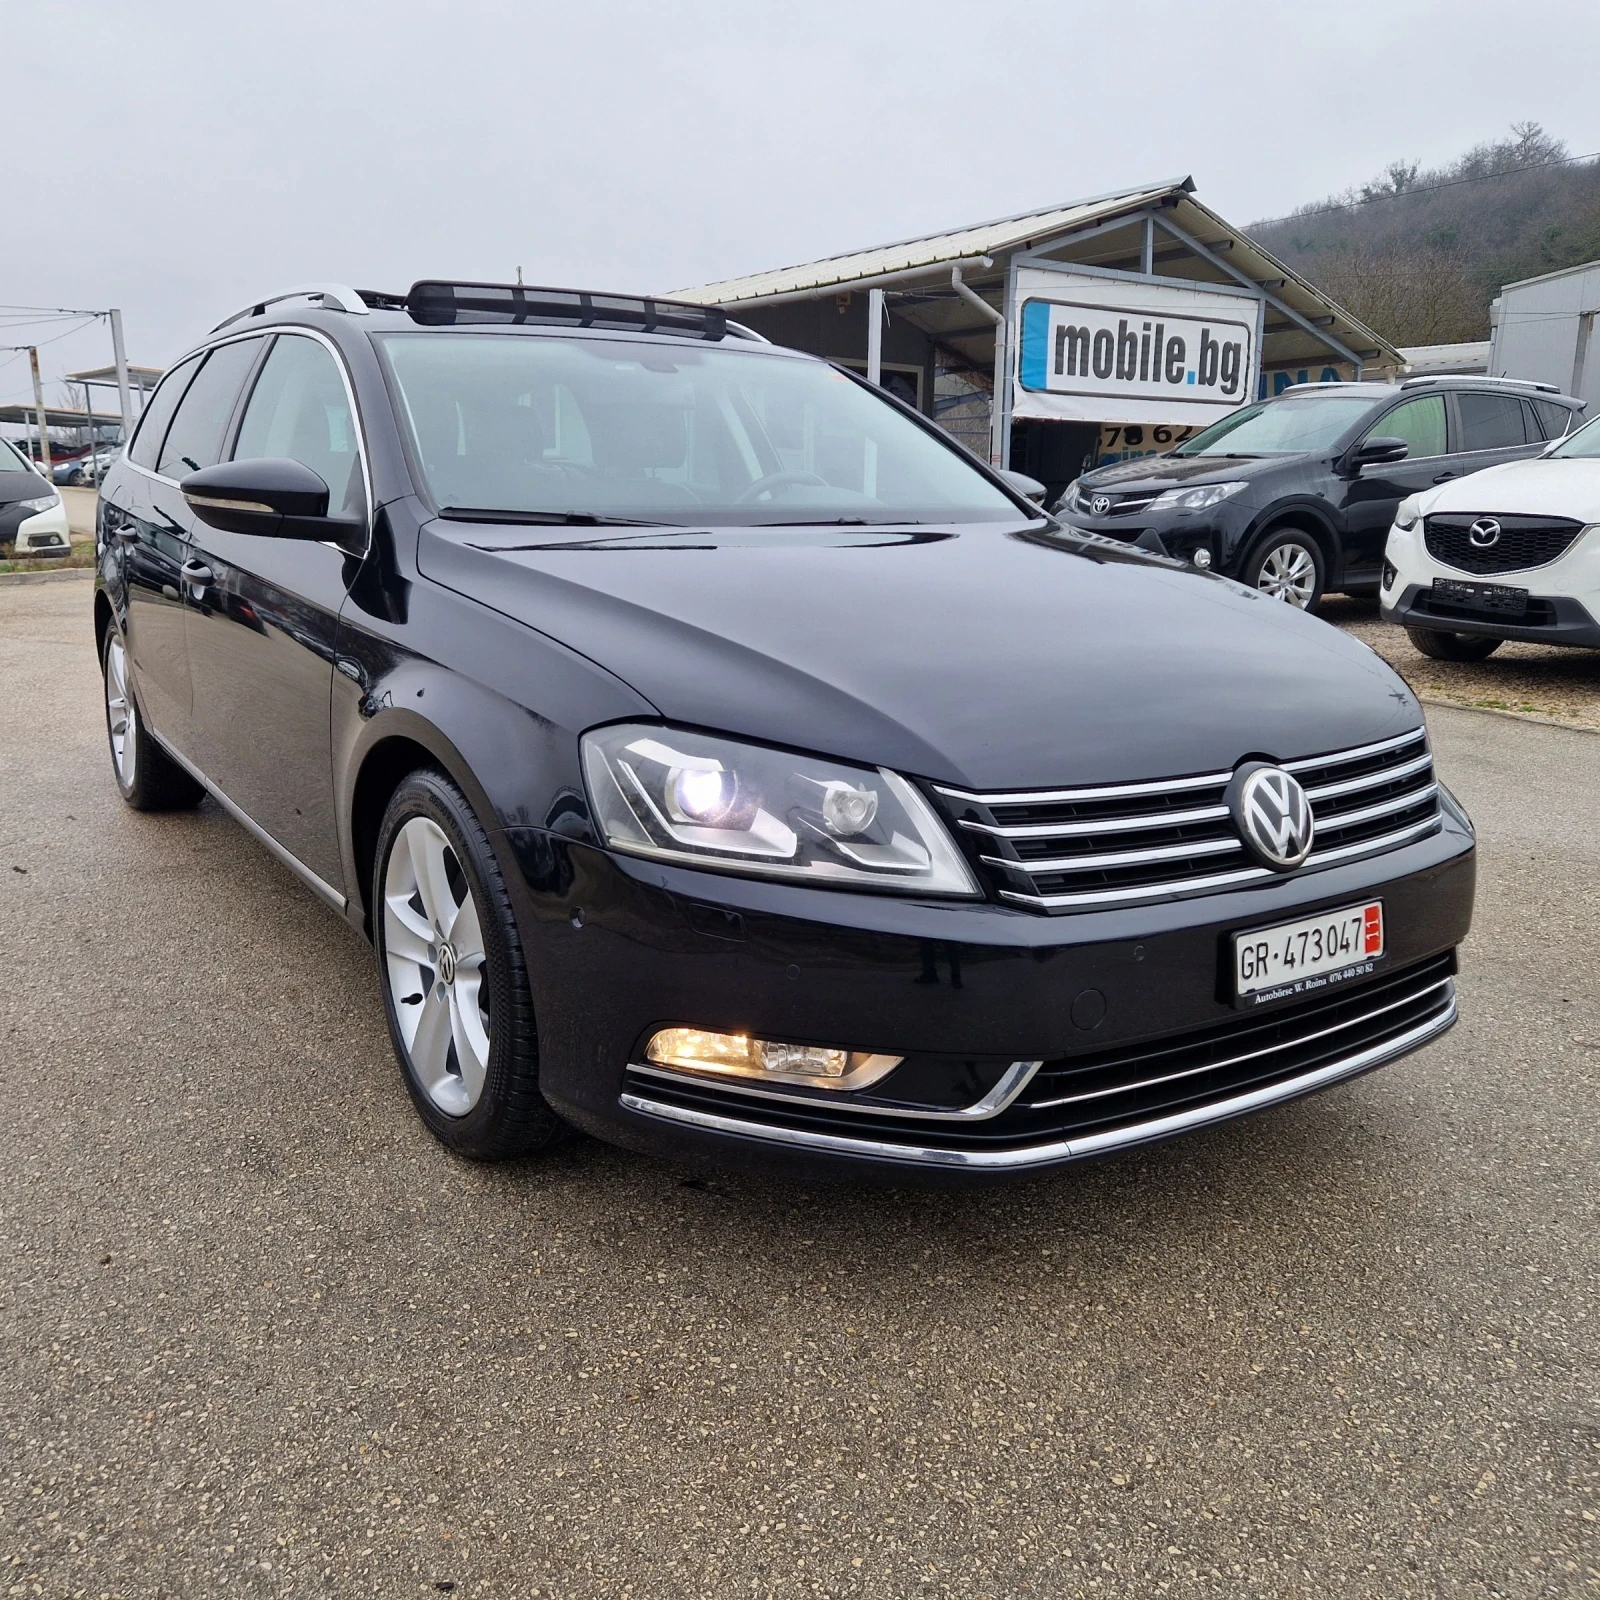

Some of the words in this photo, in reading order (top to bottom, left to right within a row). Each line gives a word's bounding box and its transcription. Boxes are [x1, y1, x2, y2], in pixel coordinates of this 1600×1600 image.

[1054, 318, 1242, 395] mobile.bg
[1254, 987, 1294, 1004] Autobörse
[1294, 982, 1304, 993] W.
[1329, 972, 1343, 983] 076
[1364, 962, 1374, 973] 82
